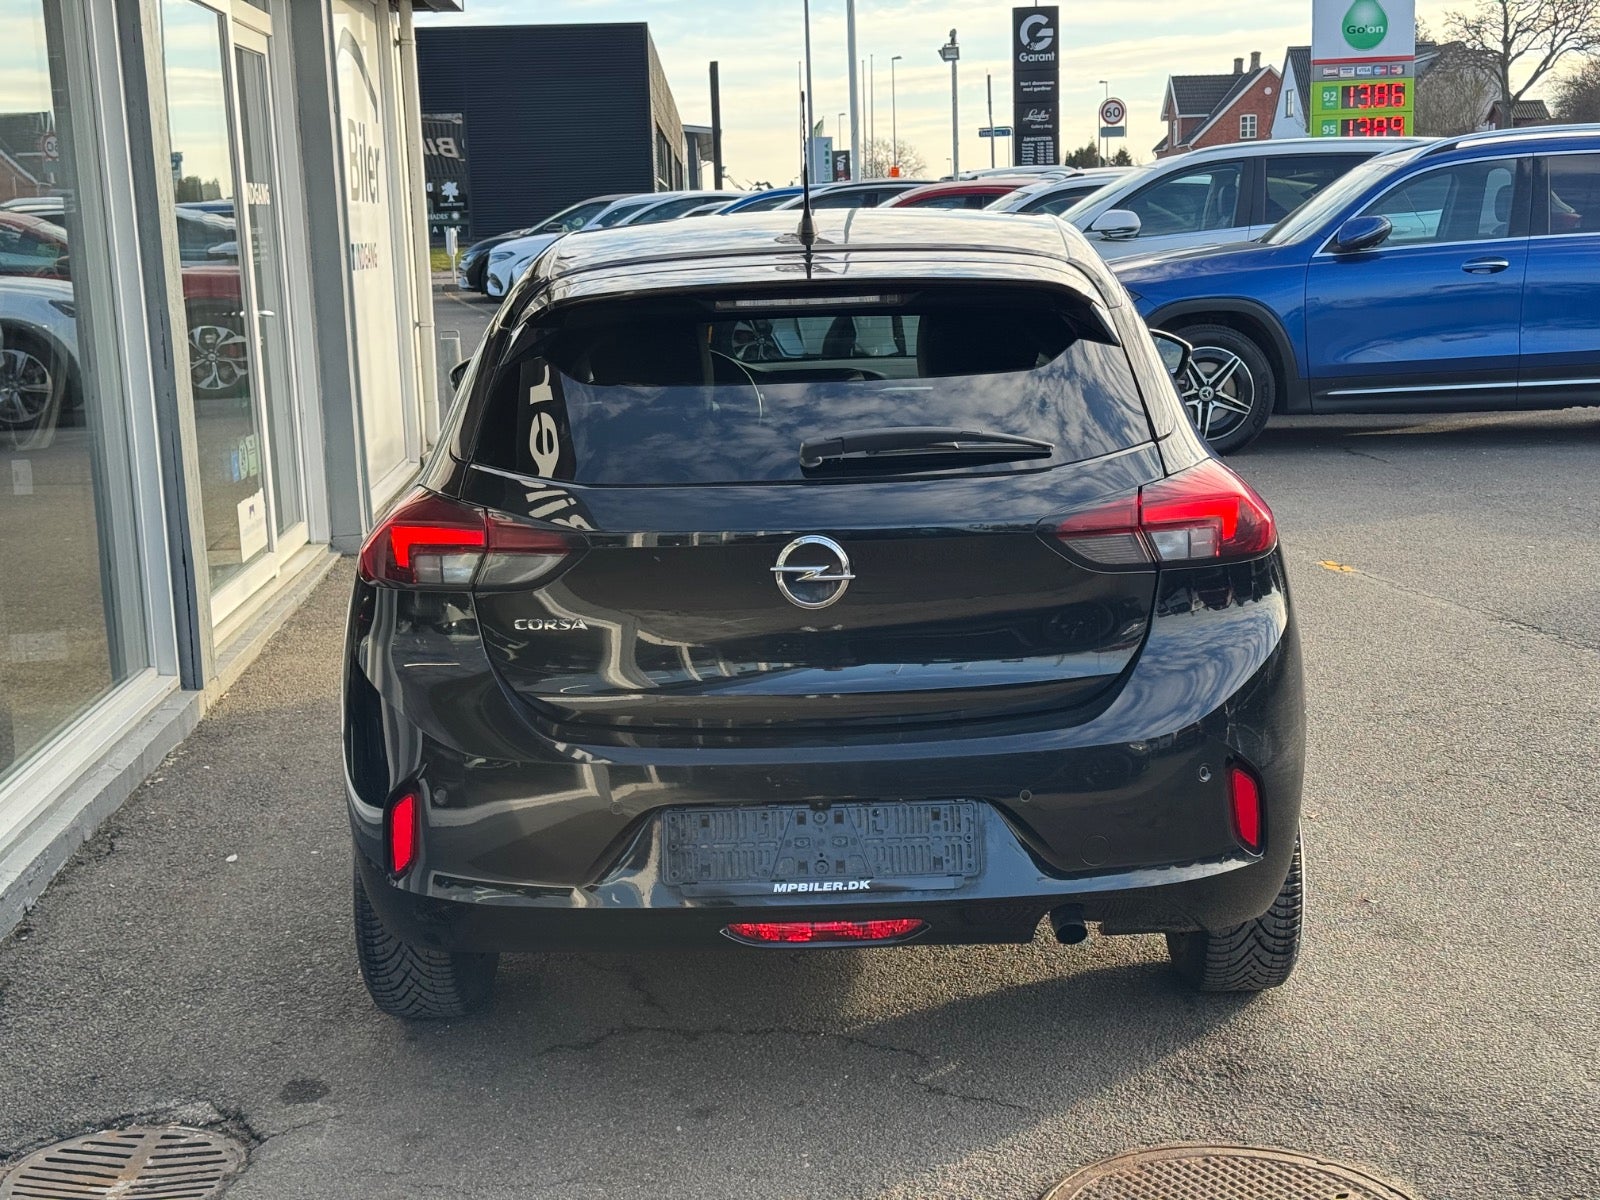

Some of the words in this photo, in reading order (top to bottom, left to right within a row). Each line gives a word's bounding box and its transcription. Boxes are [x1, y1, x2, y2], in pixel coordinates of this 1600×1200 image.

[1346, 24, 1384, 35] Go'on
[1019, 51, 1055, 63] Garant
[1322, 91, 1337, 101] 92
[1349, 82, 1405, 109] 13.86
[1105, 107, 1121, 118] 60
[1322, 125, 1337, 135] 95
[347, 118, 380, 204] Biler
[514, 618, 588, 631] CORSA
[773, 880, 872, 893] MPBILER.DK
